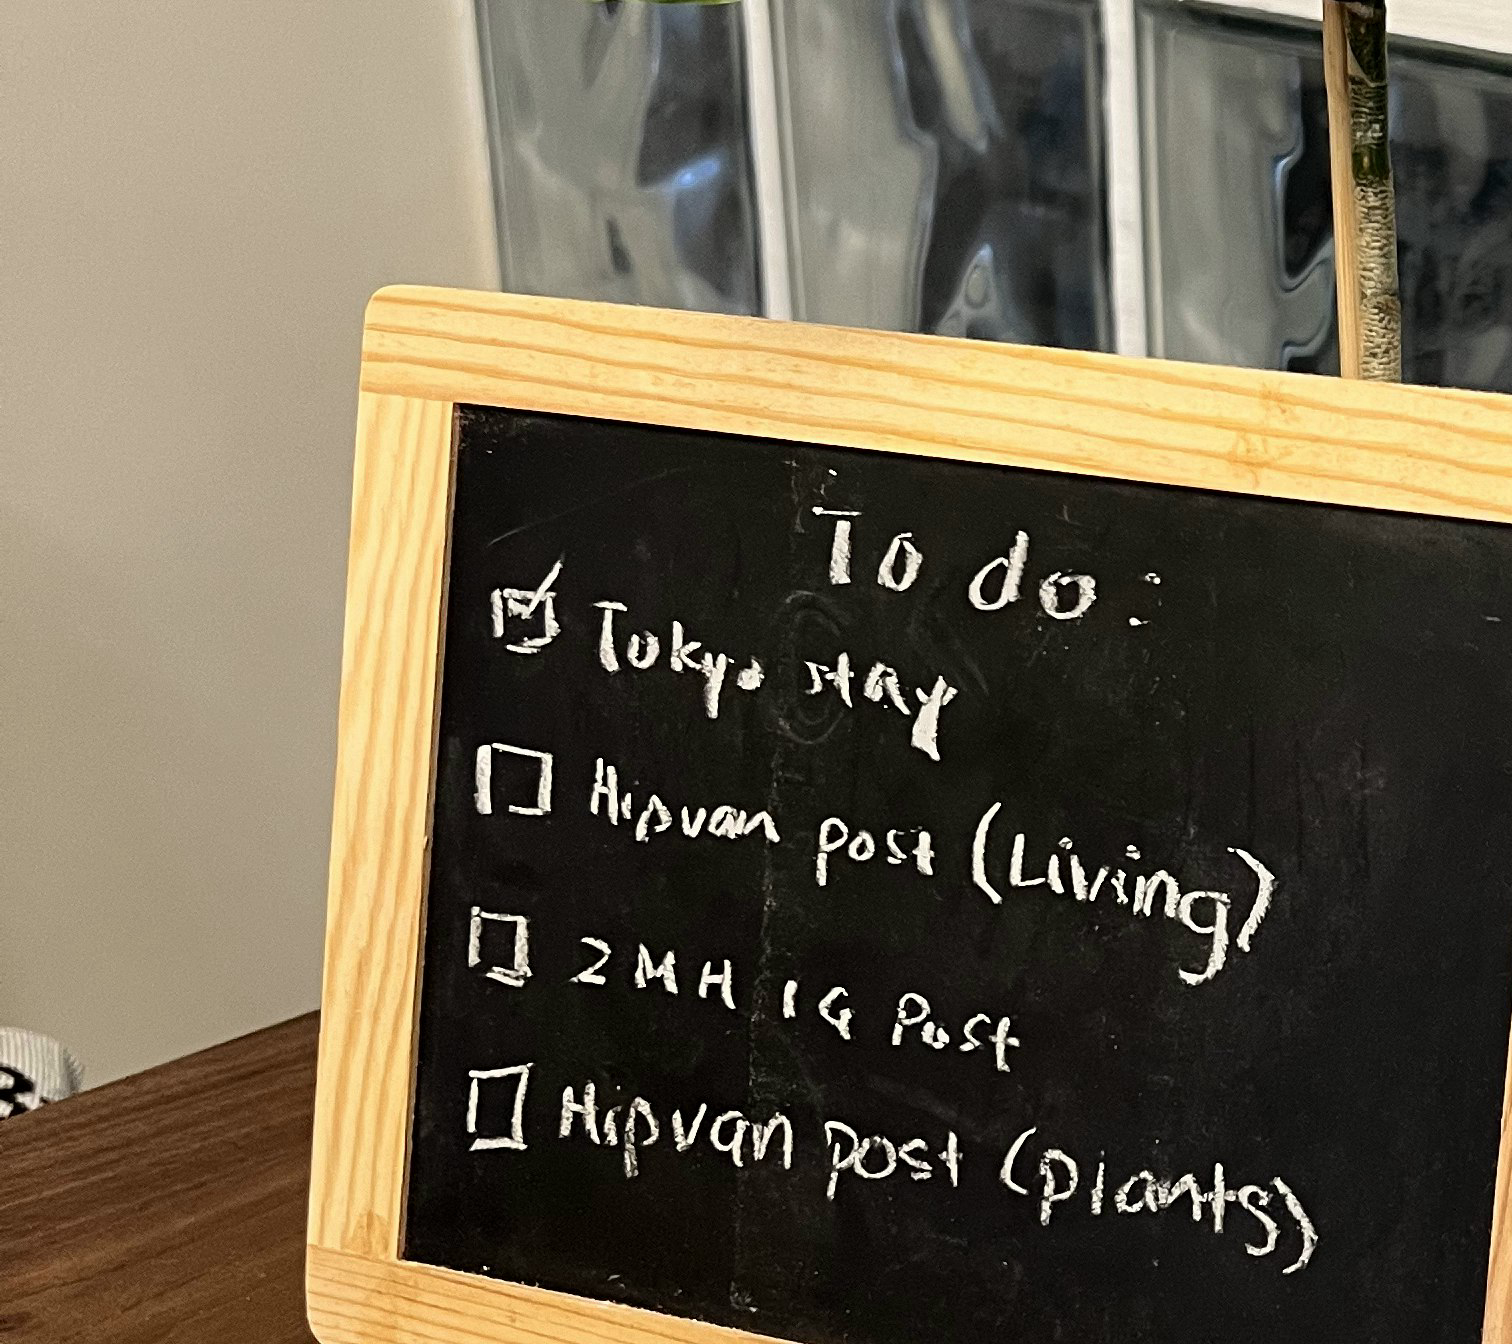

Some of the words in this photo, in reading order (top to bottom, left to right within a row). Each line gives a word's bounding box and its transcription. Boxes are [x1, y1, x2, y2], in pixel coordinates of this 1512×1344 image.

[812, 506, 922, 592] To
[593, 601, 765, 719] Tokyo
[804, 652, 958, 761] stay
[591, 757, 780, 843] Hipvan
[816, 816, 936, 887] post
[971, 802, 1275, 986] (Living)
[892, 992, 1021, 1072] Post
[559, 1081, 794, 1178] Hipvan
[825, 1120, 962, 1201] post
[1000, 1126, 1317, 1276] (plants)
